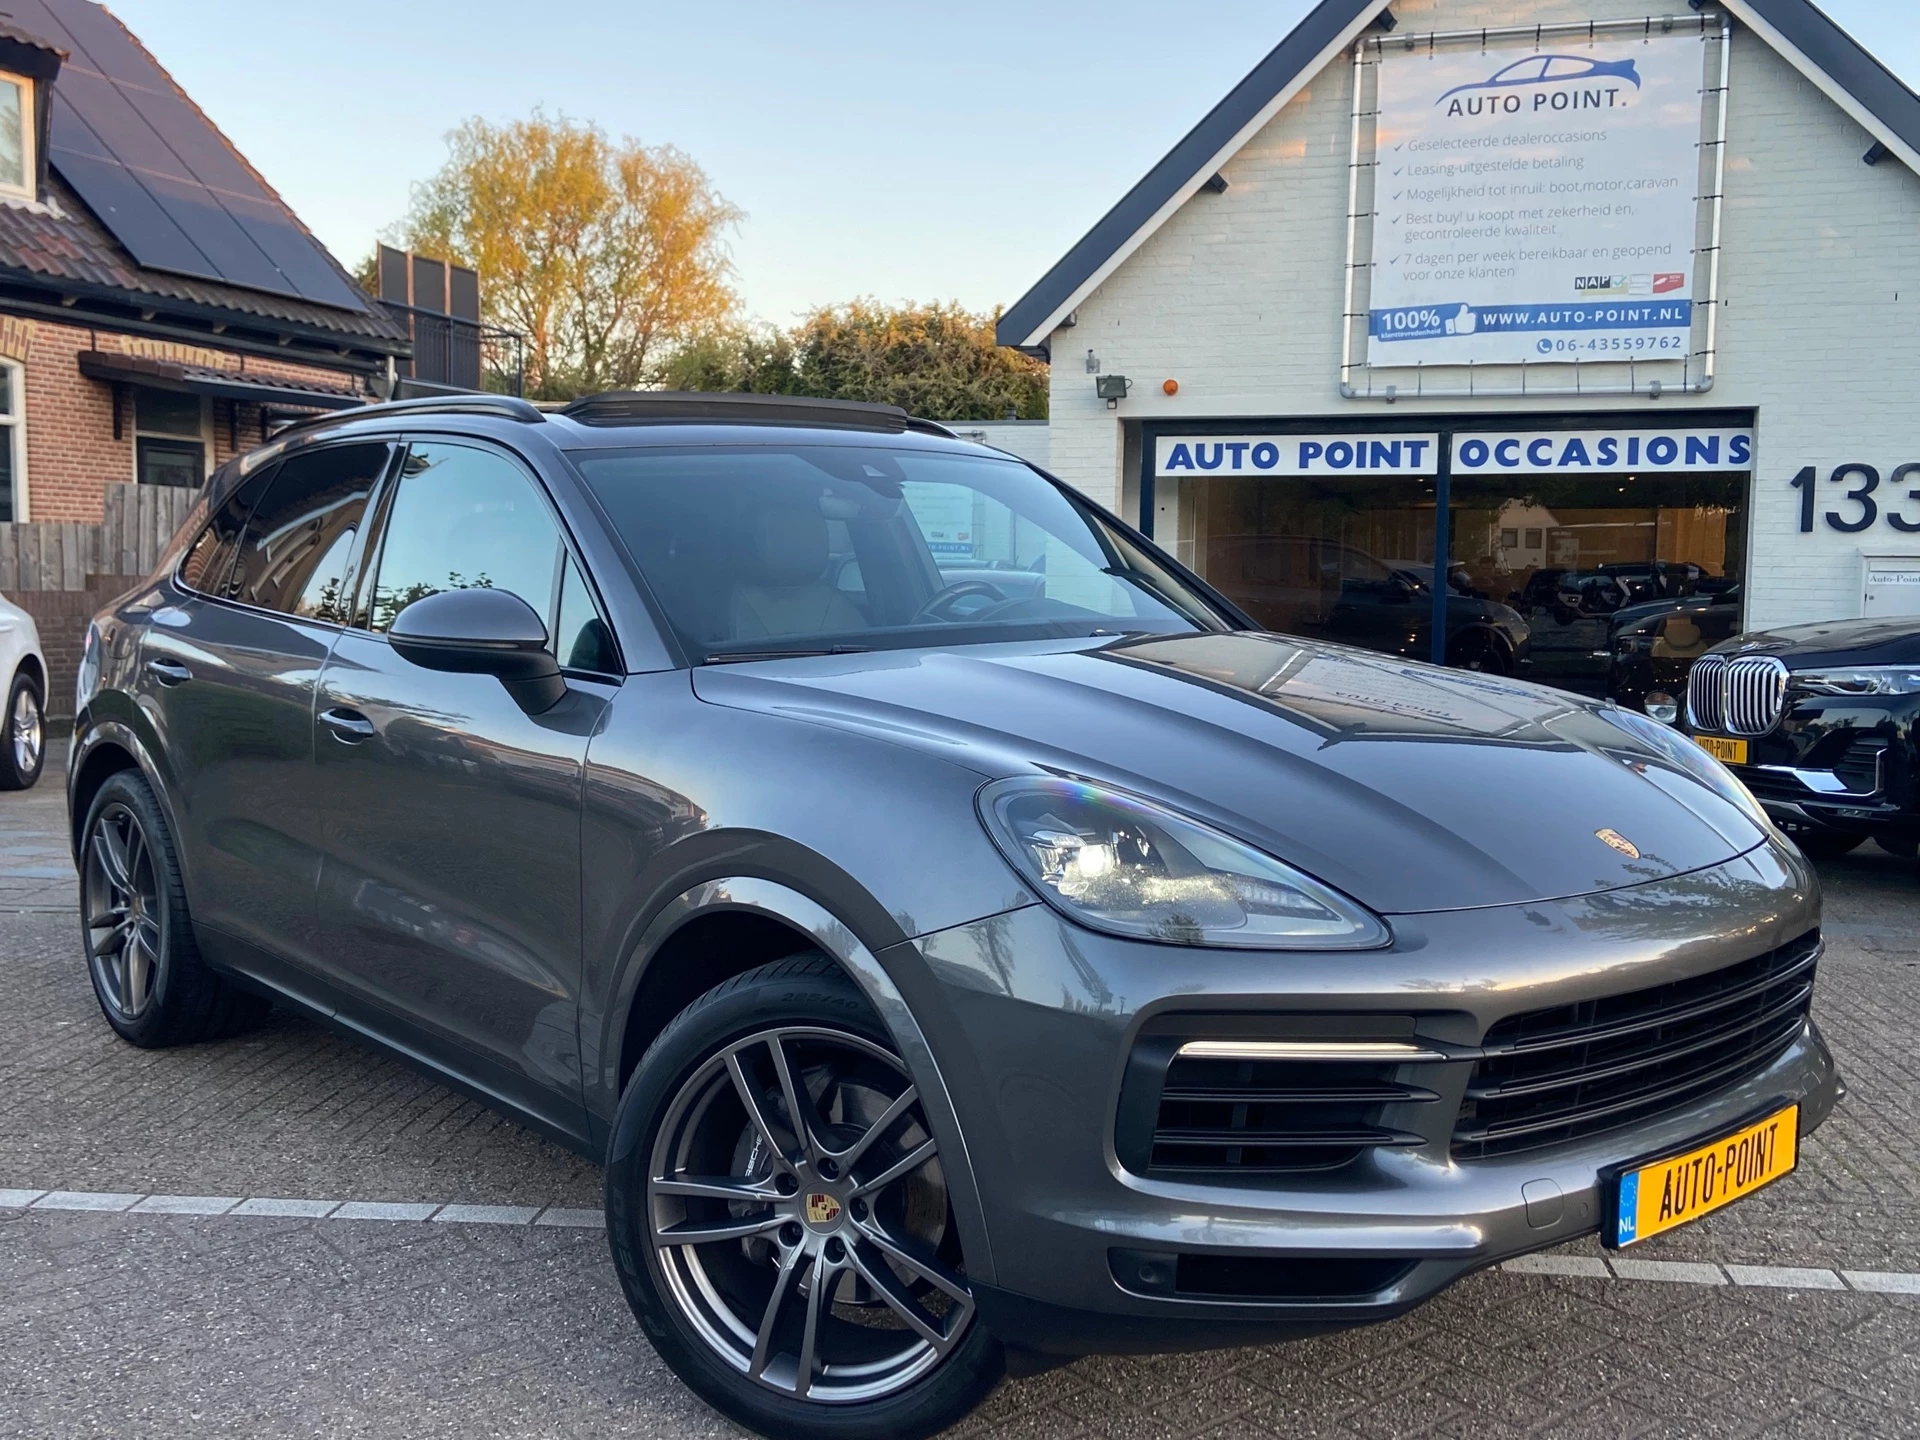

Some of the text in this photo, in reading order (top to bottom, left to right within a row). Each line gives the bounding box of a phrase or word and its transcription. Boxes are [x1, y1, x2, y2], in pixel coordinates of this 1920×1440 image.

[1447, 95, 1521, 117] AUTO
[1408, 130, 1607, 152] Geselecteerde dealeroccasions
[1407, 156, 1584, 177] Leasing-uitgestelde betaling
[1406, 185, 1485, 202] Mogelijkheid
[1489, 186, 1507, 197] tot
[1549, 177, 1679, 194] boot,motor,caravan
[1406, 204, 1635, 225] Best buy! u koopt met zekerheid en,
[1404, 223, 1557, 244] gecontroleerde kwaliteit
[1403, 243, 1672, 267] 7 dagen per week bereikbaar en geopend
[1402, 267, 1515, 281] voor onze klanten
[1575, 275, 1611, 289] NAP
[1382, 309, 1441, 330] 100%
[1482, 307, 1684, 325] WWW.AUTO-POINT.NL
[1556, 336, 1681, 352] 06-43559762
[1165, 440, 1430, 470] AUTO POINT
[1459, 435, 1751, 468] OCCASIONS
[1789, 462, 1920, 533] 133
[745, 1133, 763, 1177] RSCHE
[1619, 1122, 1778, 1235] NL AUTO-POINT
